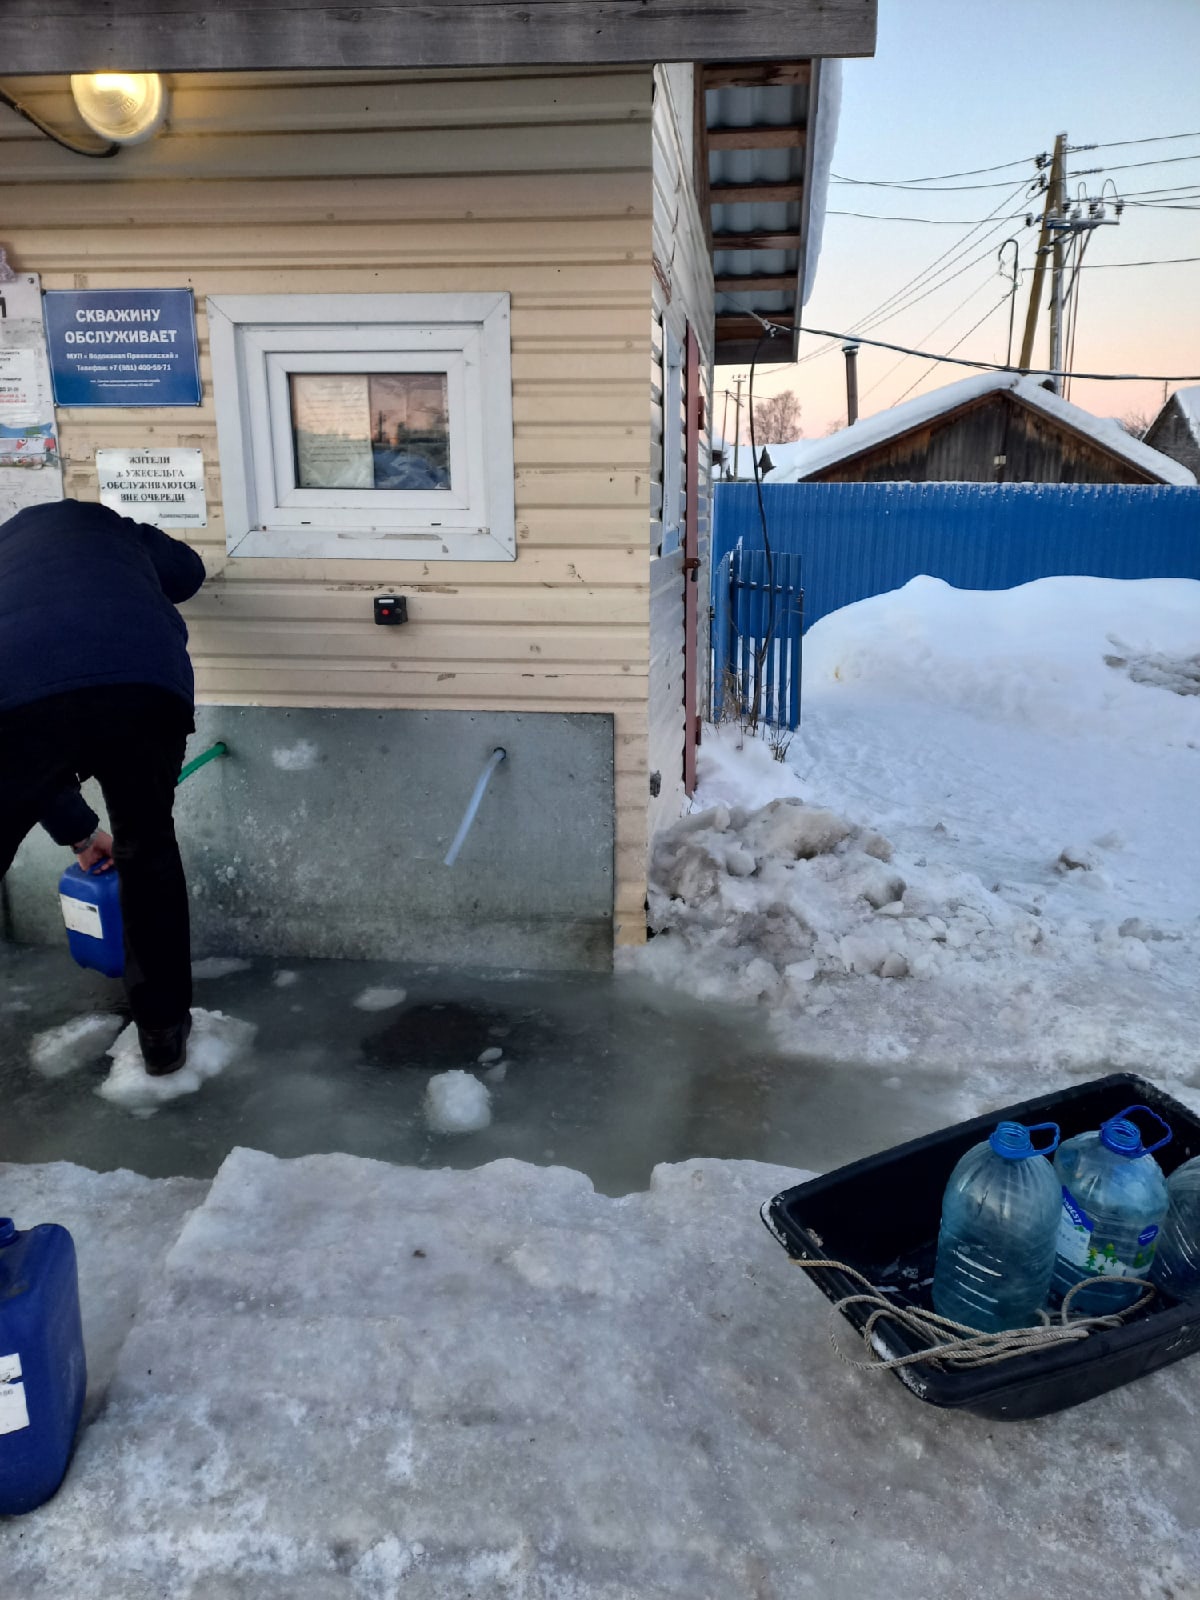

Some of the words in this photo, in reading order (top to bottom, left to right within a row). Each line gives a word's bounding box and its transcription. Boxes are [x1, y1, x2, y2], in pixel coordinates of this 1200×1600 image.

[75, 309, 161, 322] СКВАЖИНУ
[64, 330, 178, 343] ОБСЛУЖИВАЕТ
[66, 352, 83, 360] МУП
[129, 456, 170, 464] ЖИТЕЛИ
[126, 469, 185, 478] УЖЕСЕЛЬГА
[106, 481, 197, 490] ОБСЛУЖИВАЮТСЯ
[120, 493, 139, 501] ВНЕ
[141, 493, 185, 501] ОЧЕРЕДИ
